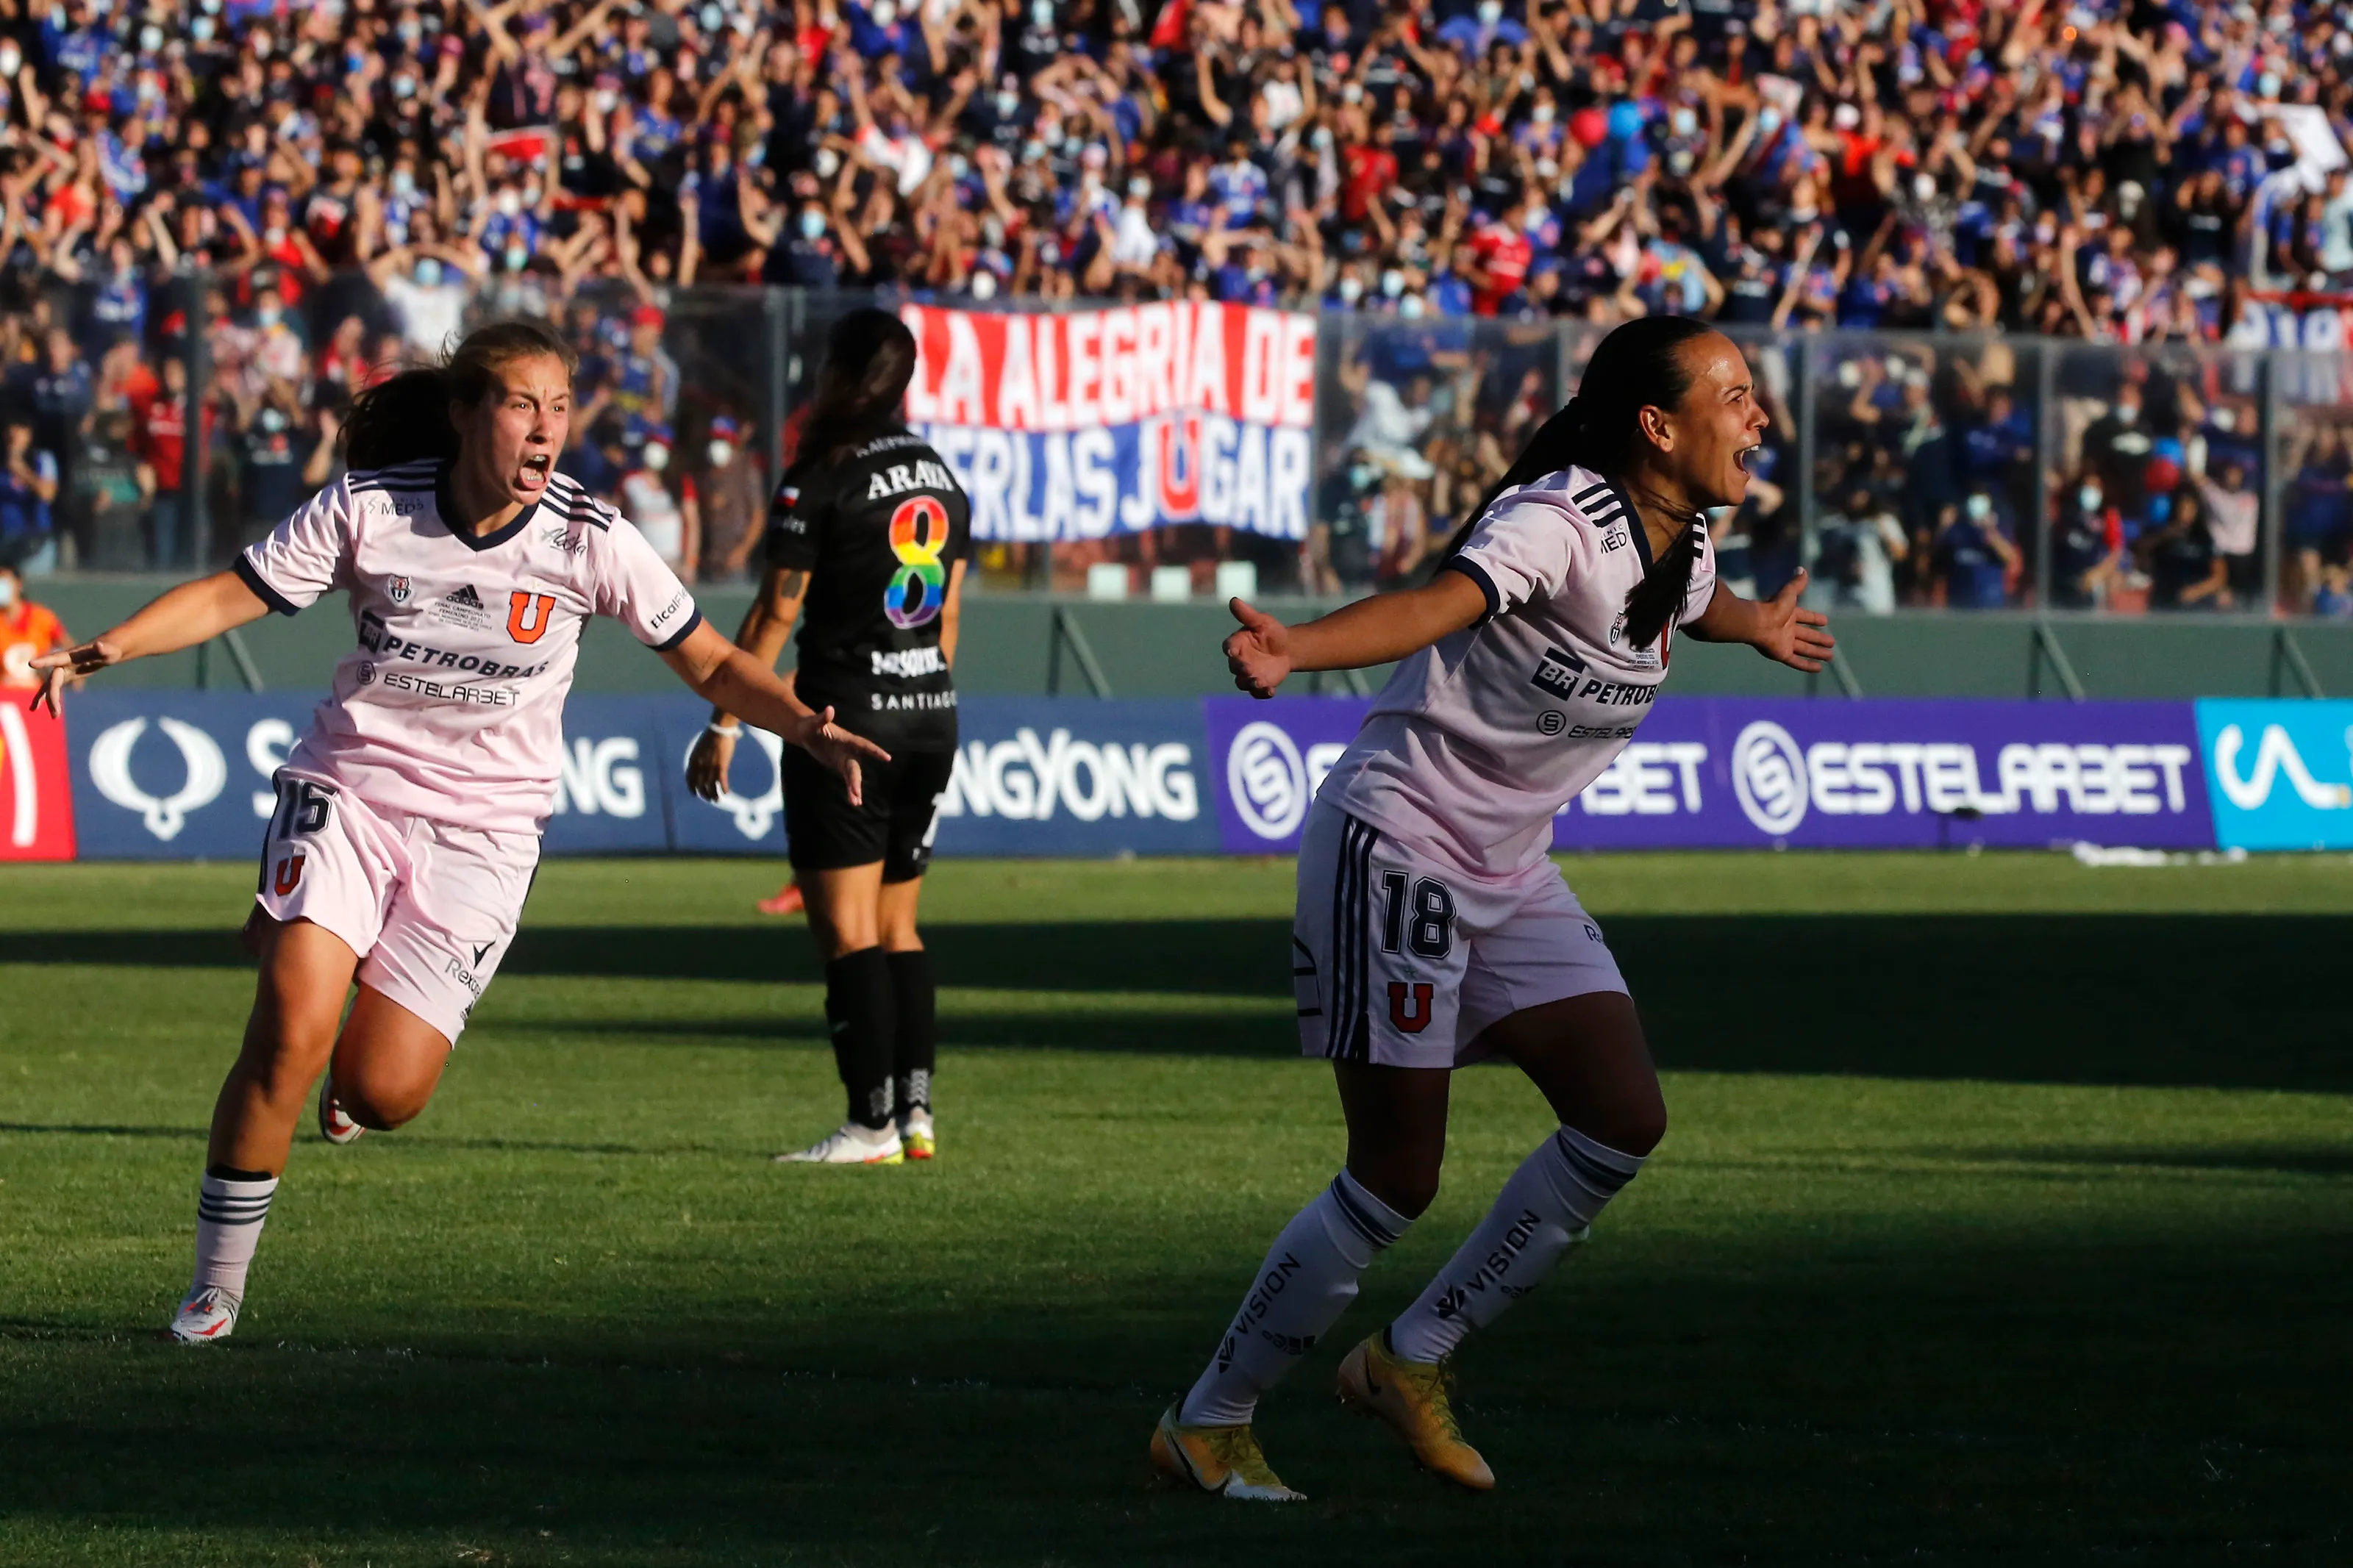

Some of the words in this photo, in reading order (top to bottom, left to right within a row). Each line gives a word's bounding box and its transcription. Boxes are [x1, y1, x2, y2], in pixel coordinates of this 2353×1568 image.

[901, 303, 984, 426] LA
[998, 299, 1229, 429] ALEGRIA
[1243, 309, 1315, 428] DE
[907, 422, 1115, 544] ERLAS
[1120, 407, 1311, 540] JUGAR
[884, 495, 949, 630] 8
[446, 594, 484, 609] adidas
[506, 591, 556, 644] U
[383, 635, 549, 678] PETROBRAS
[1538, 662, 1575, 690] BR
[383, 673, 521, 706] ESTELARBET
[1577, 679, 1658, 706] PETROB
[1806, 742, 2192, 815] ESTELARBET
[277, 778, 339, 842] 15
[274, 854, 306, 898] U
[1381, 869, 1457, 959] 18
[1388, 981, 1434, 1034] U
[1466, 1209, 1542, 1292] VISION
[1235, 1251, 1302, 1334] VISION
